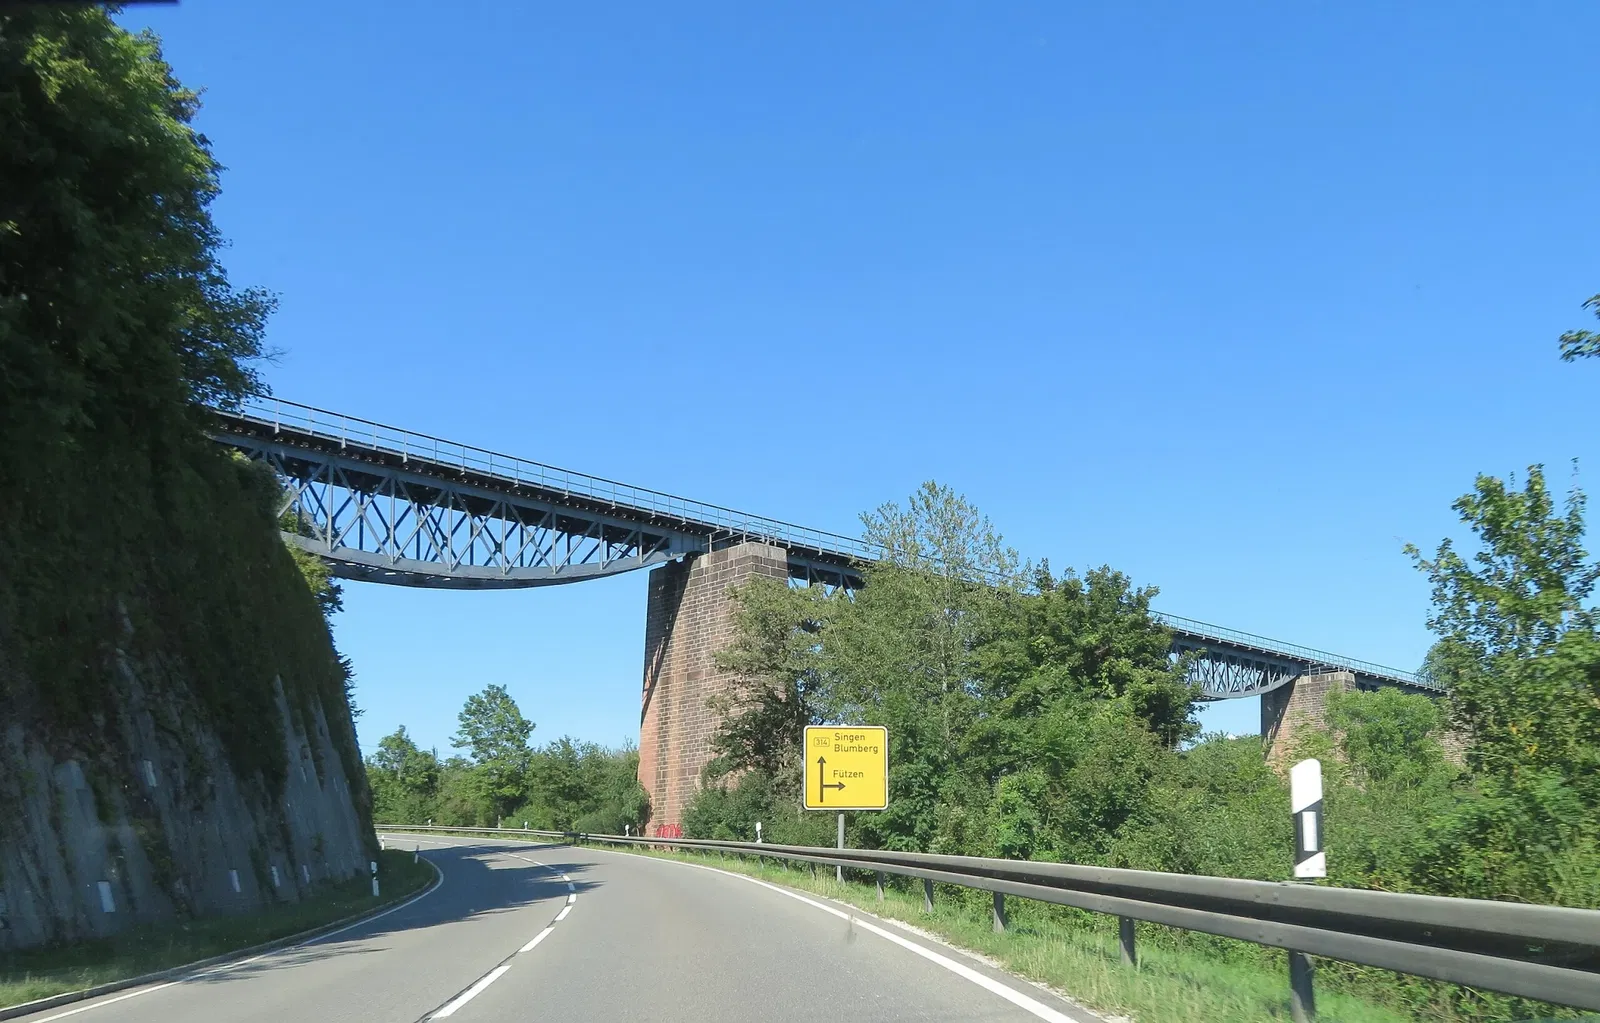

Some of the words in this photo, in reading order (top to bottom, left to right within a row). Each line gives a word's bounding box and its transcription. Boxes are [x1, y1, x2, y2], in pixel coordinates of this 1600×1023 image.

[815, 738, 828, 746] 314
[834, 732, 866, 743] Singen
[834, 744, 879, 754] Blumberg
[833, 769, 864, 778] Fützen
